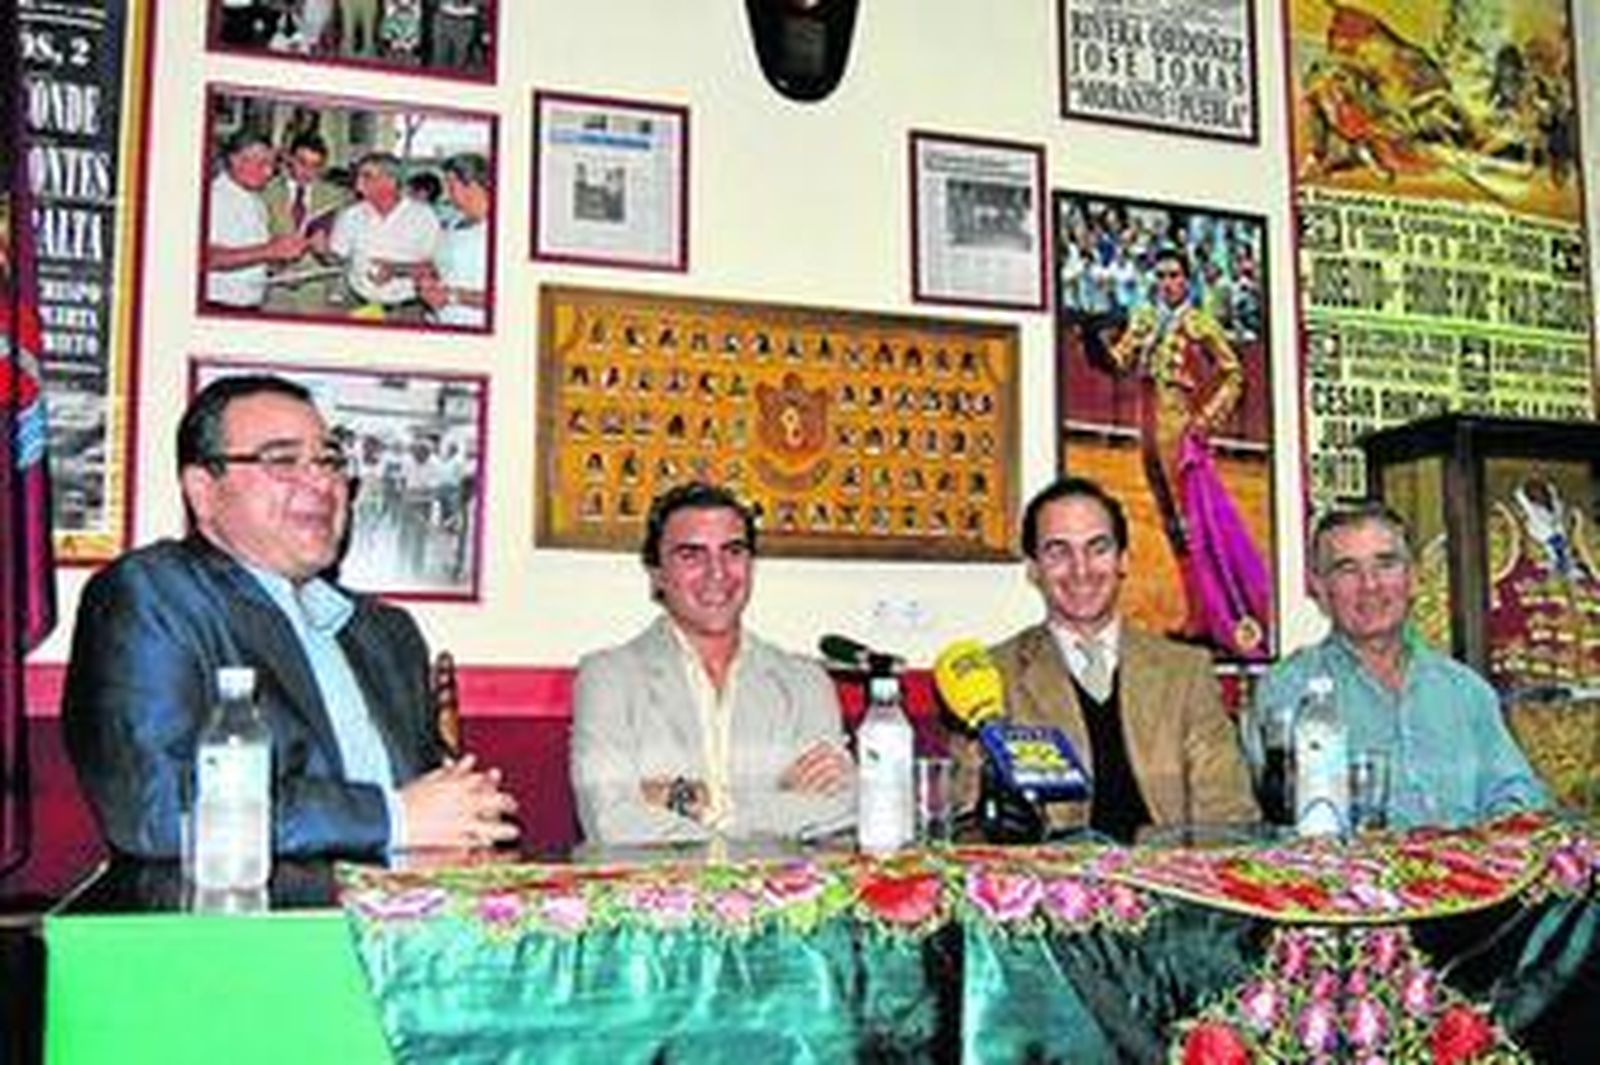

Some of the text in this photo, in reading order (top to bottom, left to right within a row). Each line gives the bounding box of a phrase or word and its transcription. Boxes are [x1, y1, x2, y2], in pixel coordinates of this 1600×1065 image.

[1071, 11, 1144, 50] RIVERA
[70, 38, 92, 67] 2
[31, 206, 102, 263] ALTA
[1311, 382, 1376, 416] CESAR
